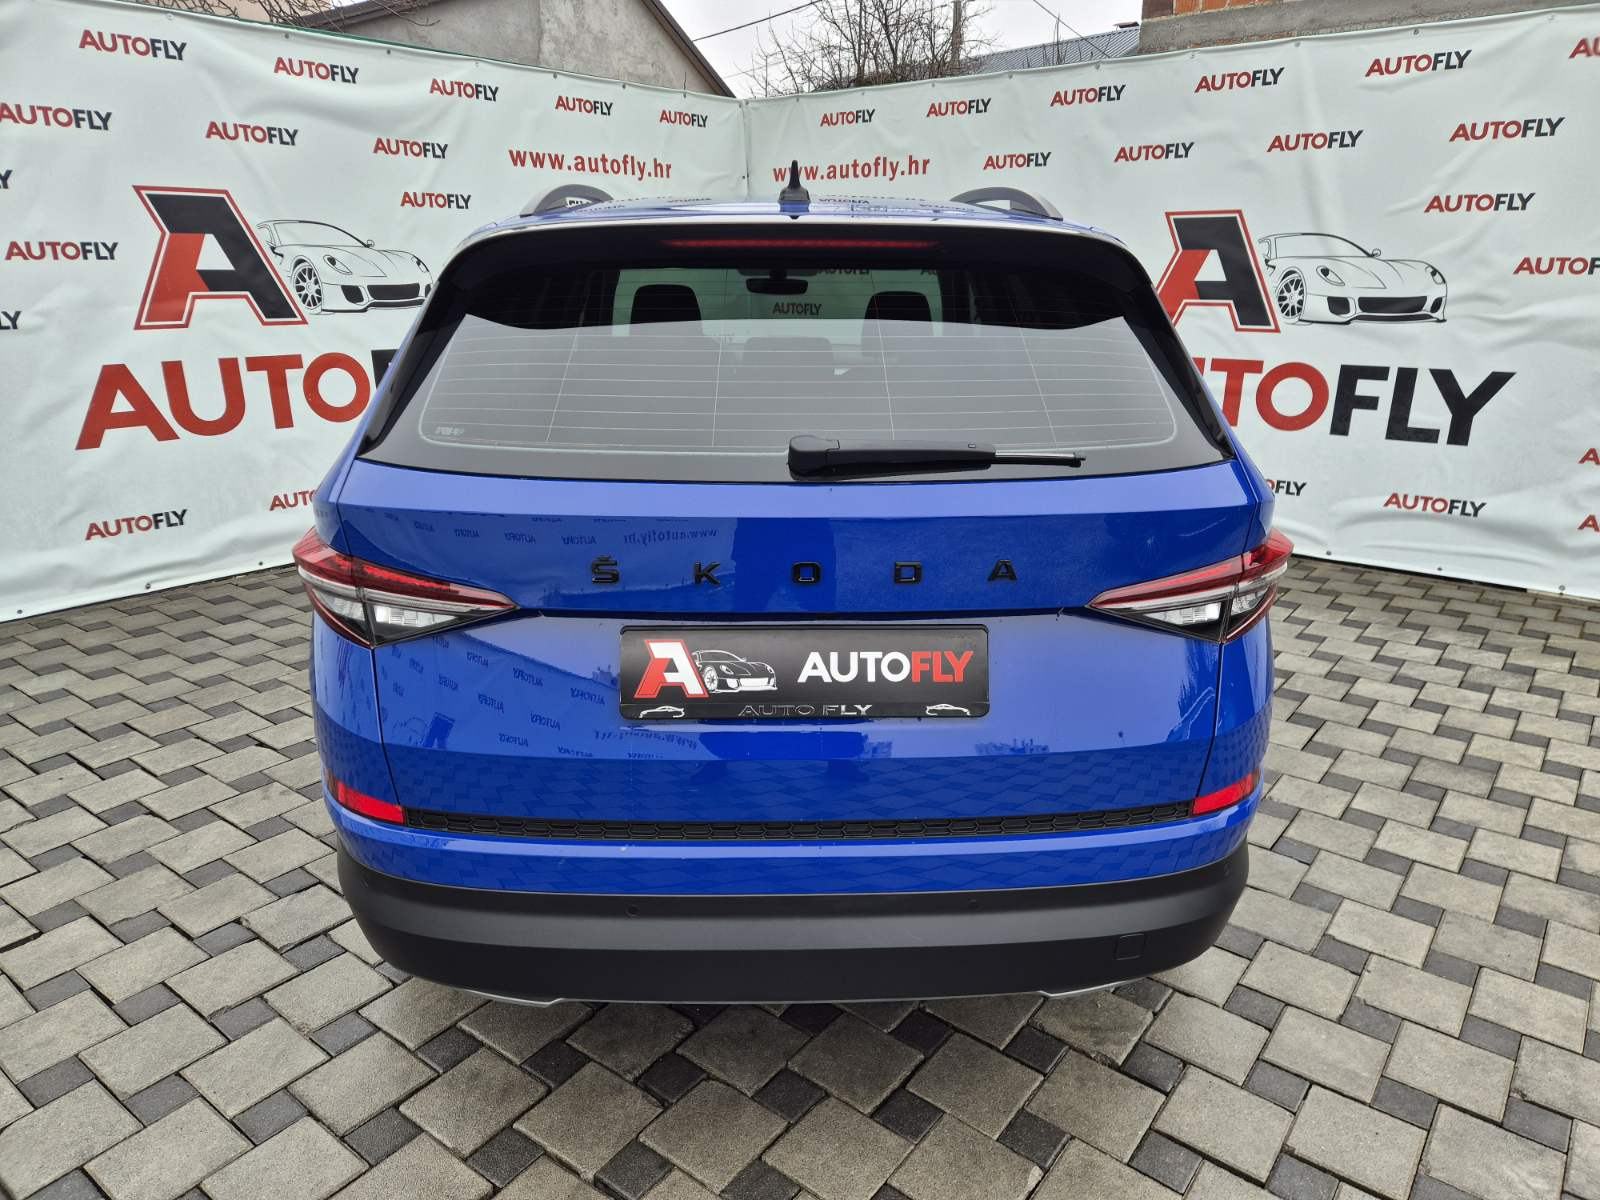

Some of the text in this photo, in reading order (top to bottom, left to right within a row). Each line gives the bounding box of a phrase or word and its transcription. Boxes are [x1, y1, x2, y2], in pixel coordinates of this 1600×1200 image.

[80, 30, 187, 61] AUTOFLY
[274, 56, 360, 85] AUTOFLY
[1365, 50, 1473, 77] AUTOFLY
[430, 79, 499, 102] AUTOFLY
[1194, 67, 1285, 93] AUTOFLY
[555, 95, 614, 116] AUTOFLY
[1050, 84, 1127, 107] AUTOFLY
[0, 103, 113, 131] AUTOFLY
[659, 109, 708, 128] AUTOFLY
[820, 108, 876, 127] AUTOFLY
[926, 98, 992, 118] AUTOFLY
[205, 121, 299, 146] AUTOFLY
[1449, 117, 1566, 142] AUTOFLY
[373, 137, 449, 159] AUTOFLY
[1115, 142, 1195, 163] AUTOFLY
[1266, 130, 1364, 153] AUTOFLY
[509, 149, 673, 181] www.autofly.hr
[773, 155, 931, 182] ww.autofly.hr
[984, 151, 1052, 170] AUTOFLY
[400, 191, 472, 210] AUTOFLY
[1424, 192, 1536, 213] AUTOFLY
[5, 241, 119, 261] AUTOFLY
[1192, 357, 1517, 446] TOFLY
[1383, 492, 1487, 518] AUTOFLY
[85, 508, 188, 541] AUTOFLY
[797, 650, 974, 683] AUTOFLY
[738, 704, 873, 717] AUTO FLY
